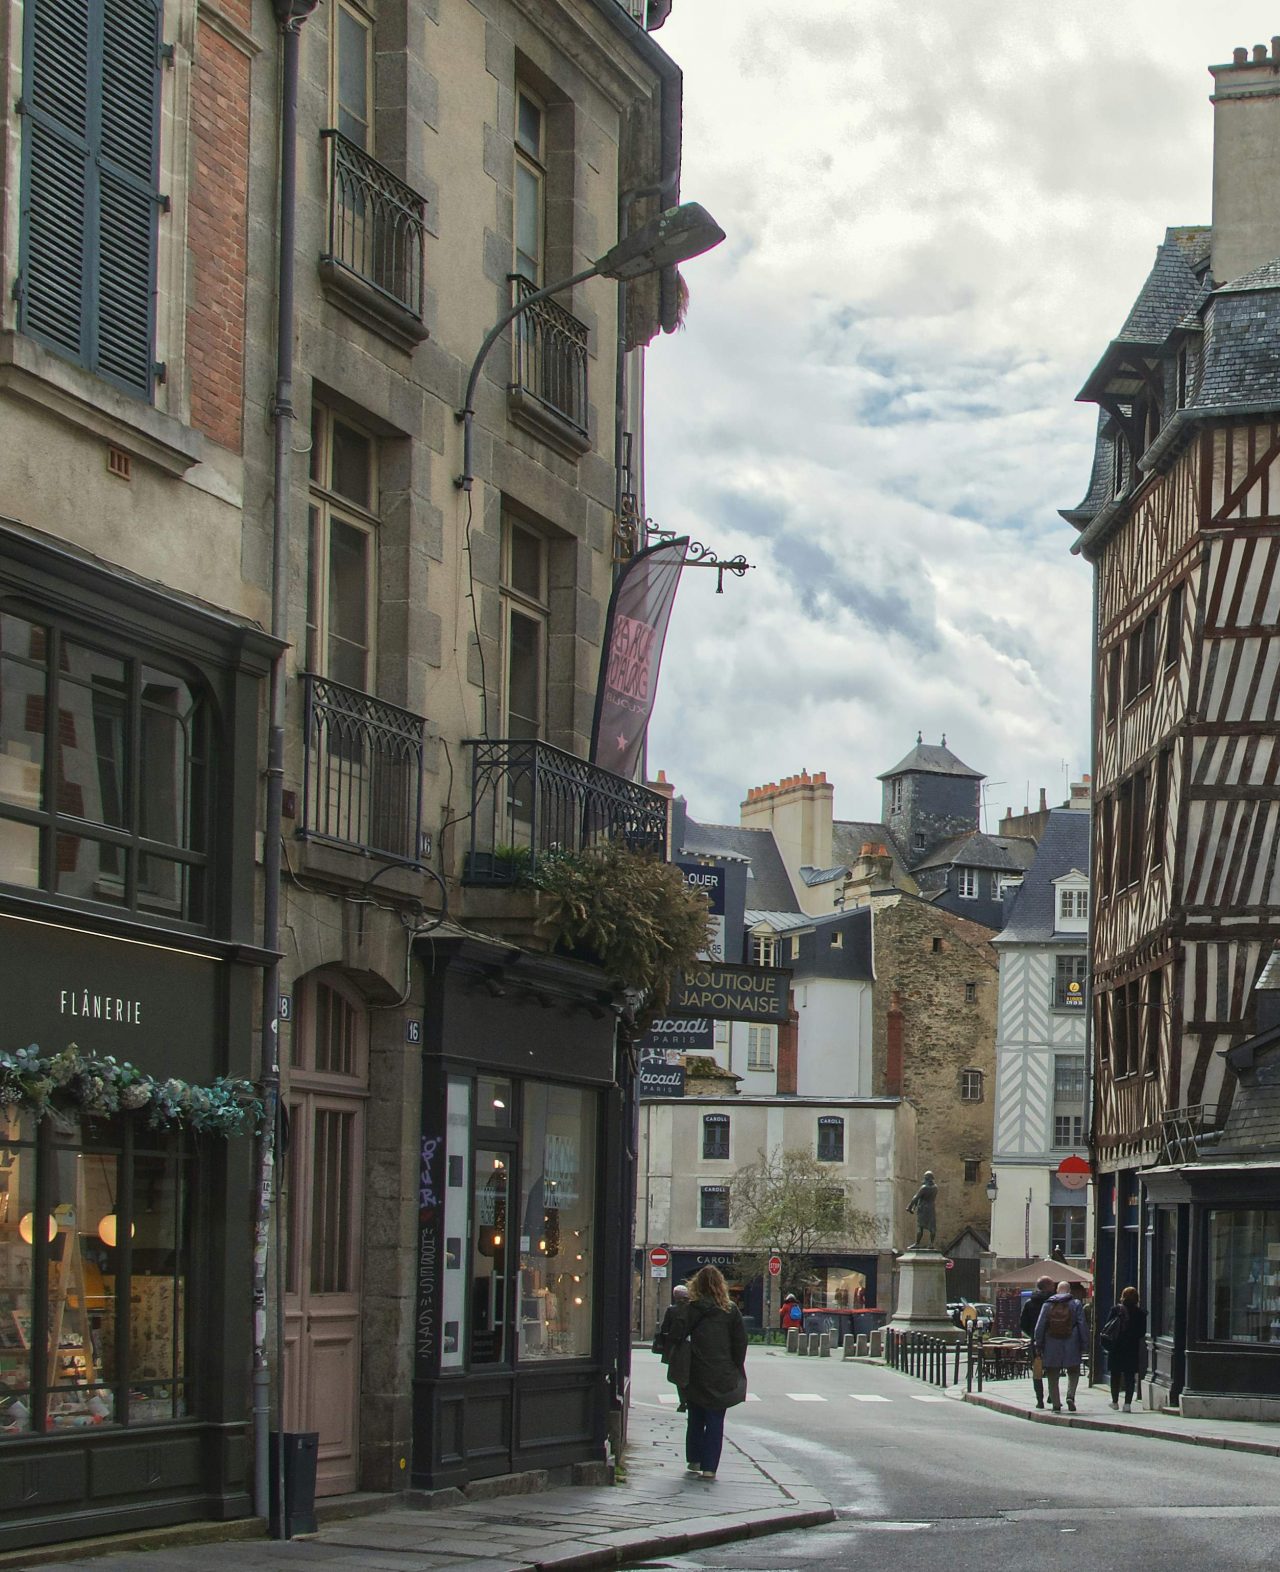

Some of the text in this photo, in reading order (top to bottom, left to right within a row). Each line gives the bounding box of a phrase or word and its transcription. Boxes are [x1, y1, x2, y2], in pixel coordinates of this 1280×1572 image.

[682, 872, 718, 887] LOUER
[712, 944, 722, 954] 85
[685, 971, 775, 993] BOUTIQUE
[61, 988, 141, 1025] FLÂNERIE
[680, 991, 780, 1013] JAPONAISE
[409, 1022, 419, 1041] 16
[651, 1018, 709, 1033] acadi
[653, 1035, 696, 1044] PARIS
[643, 1085, 673, 1093] PARIS
[696, 1255, 738, 1265] CAROLL
